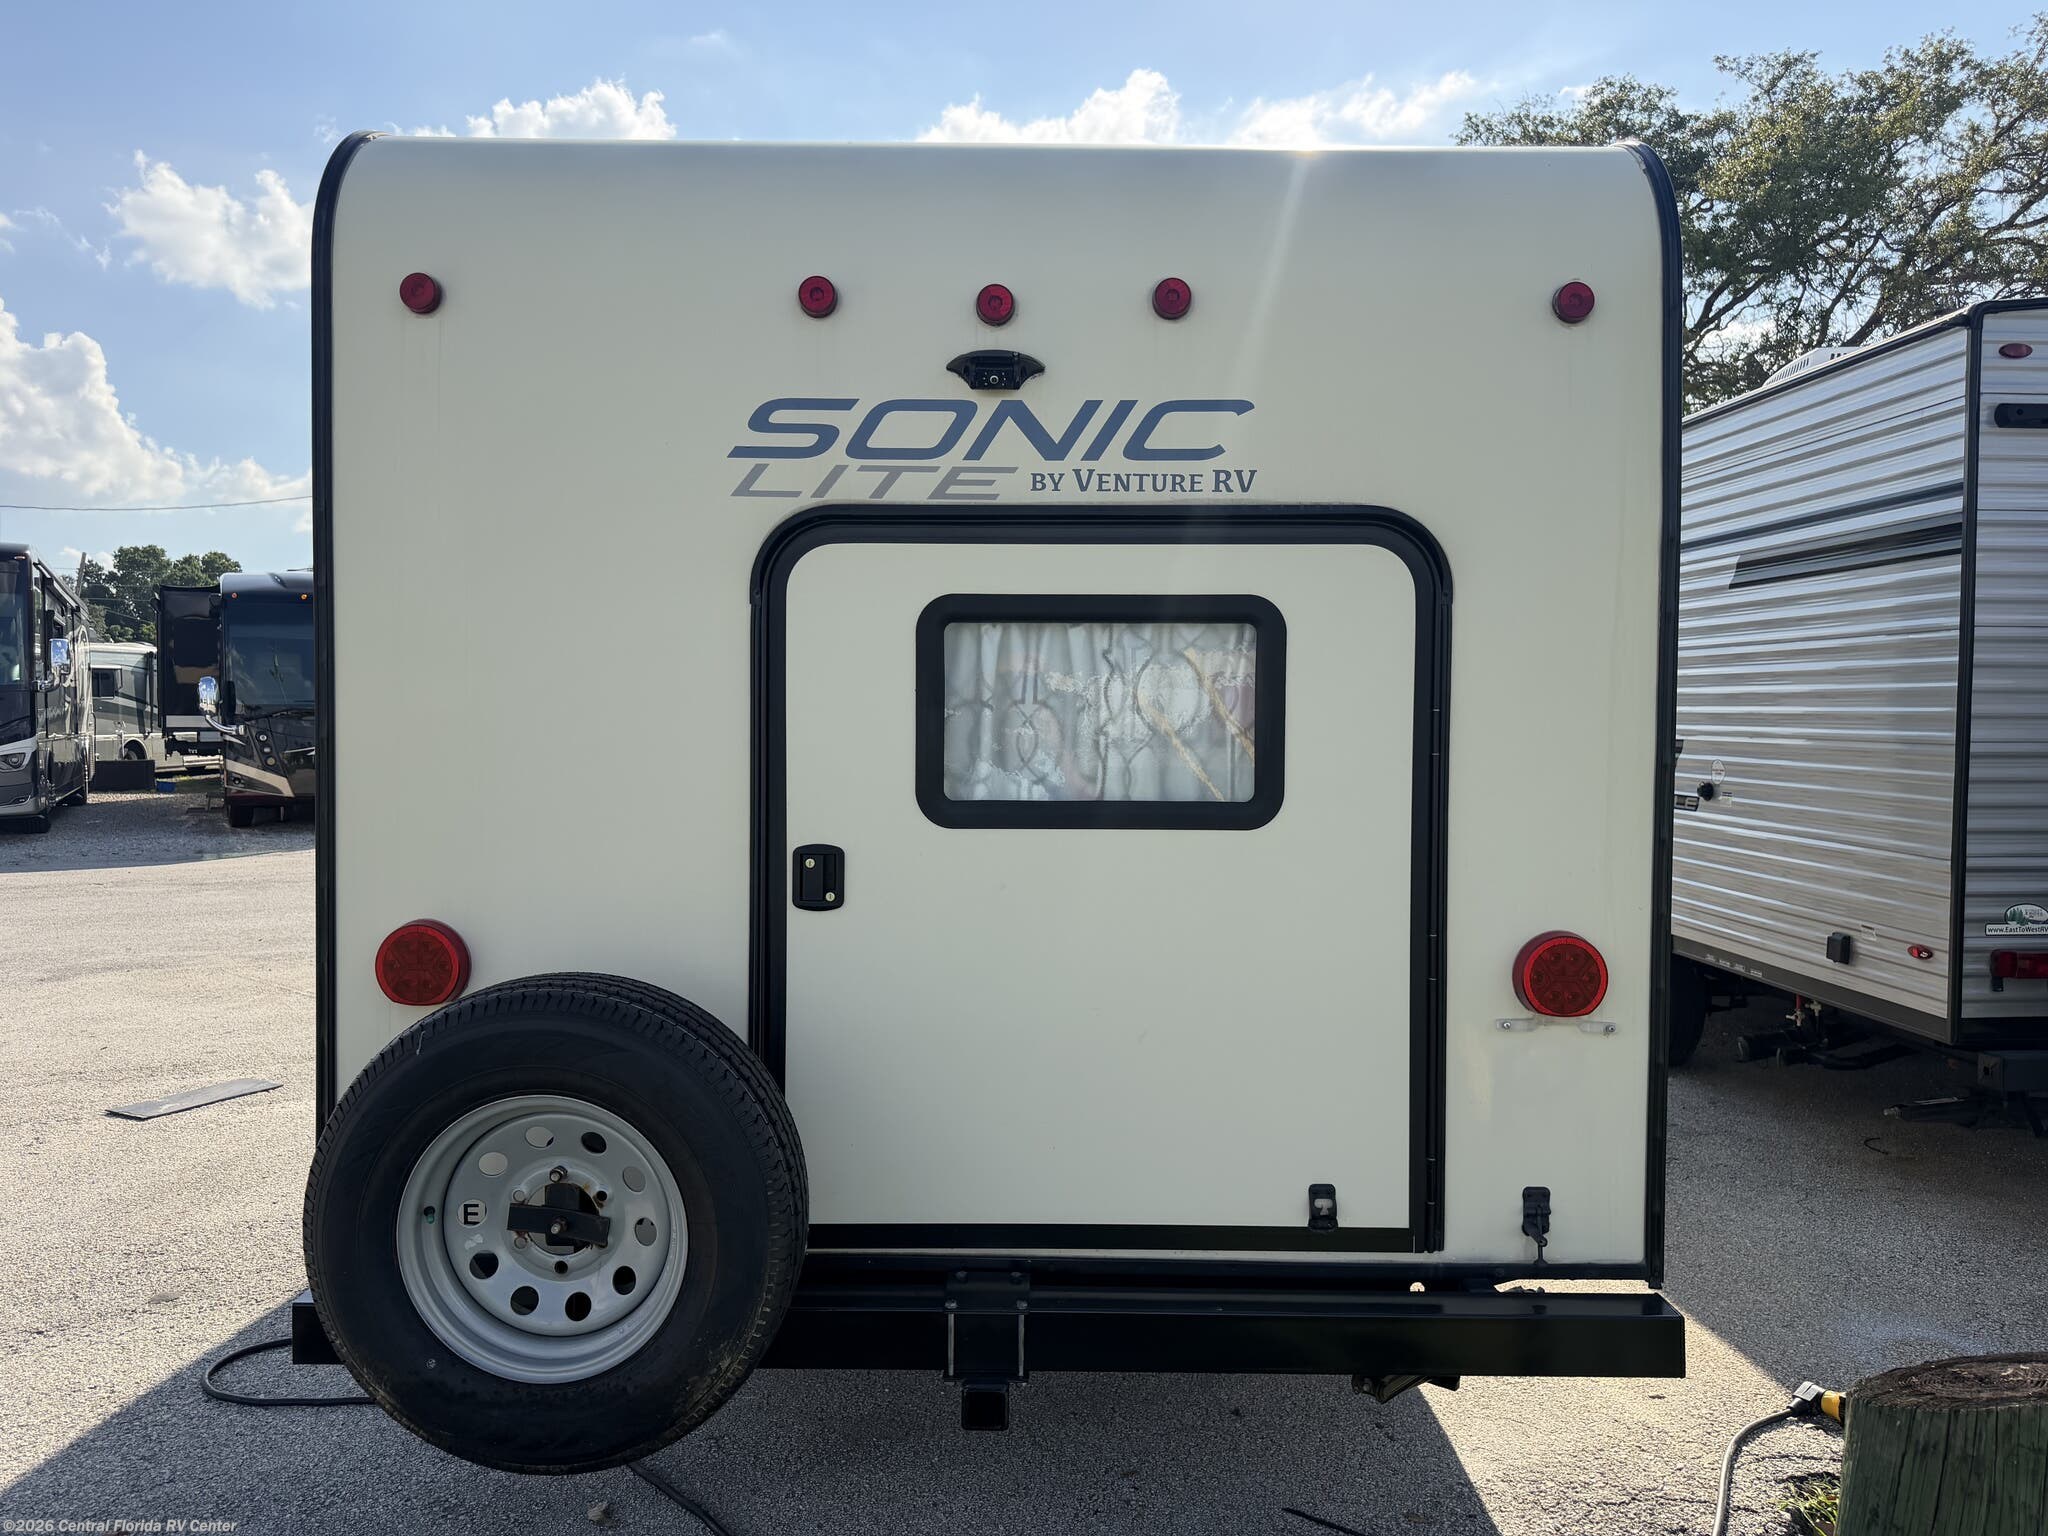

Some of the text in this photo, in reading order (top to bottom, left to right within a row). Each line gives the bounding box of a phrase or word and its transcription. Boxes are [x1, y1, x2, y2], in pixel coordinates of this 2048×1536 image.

[727, 398, 1255, 461] SONIC
[730, 463, 1018, 500] LITE
[1030, 473, 1065, 492] BY
[1212, 469, 1257, 493] RV
